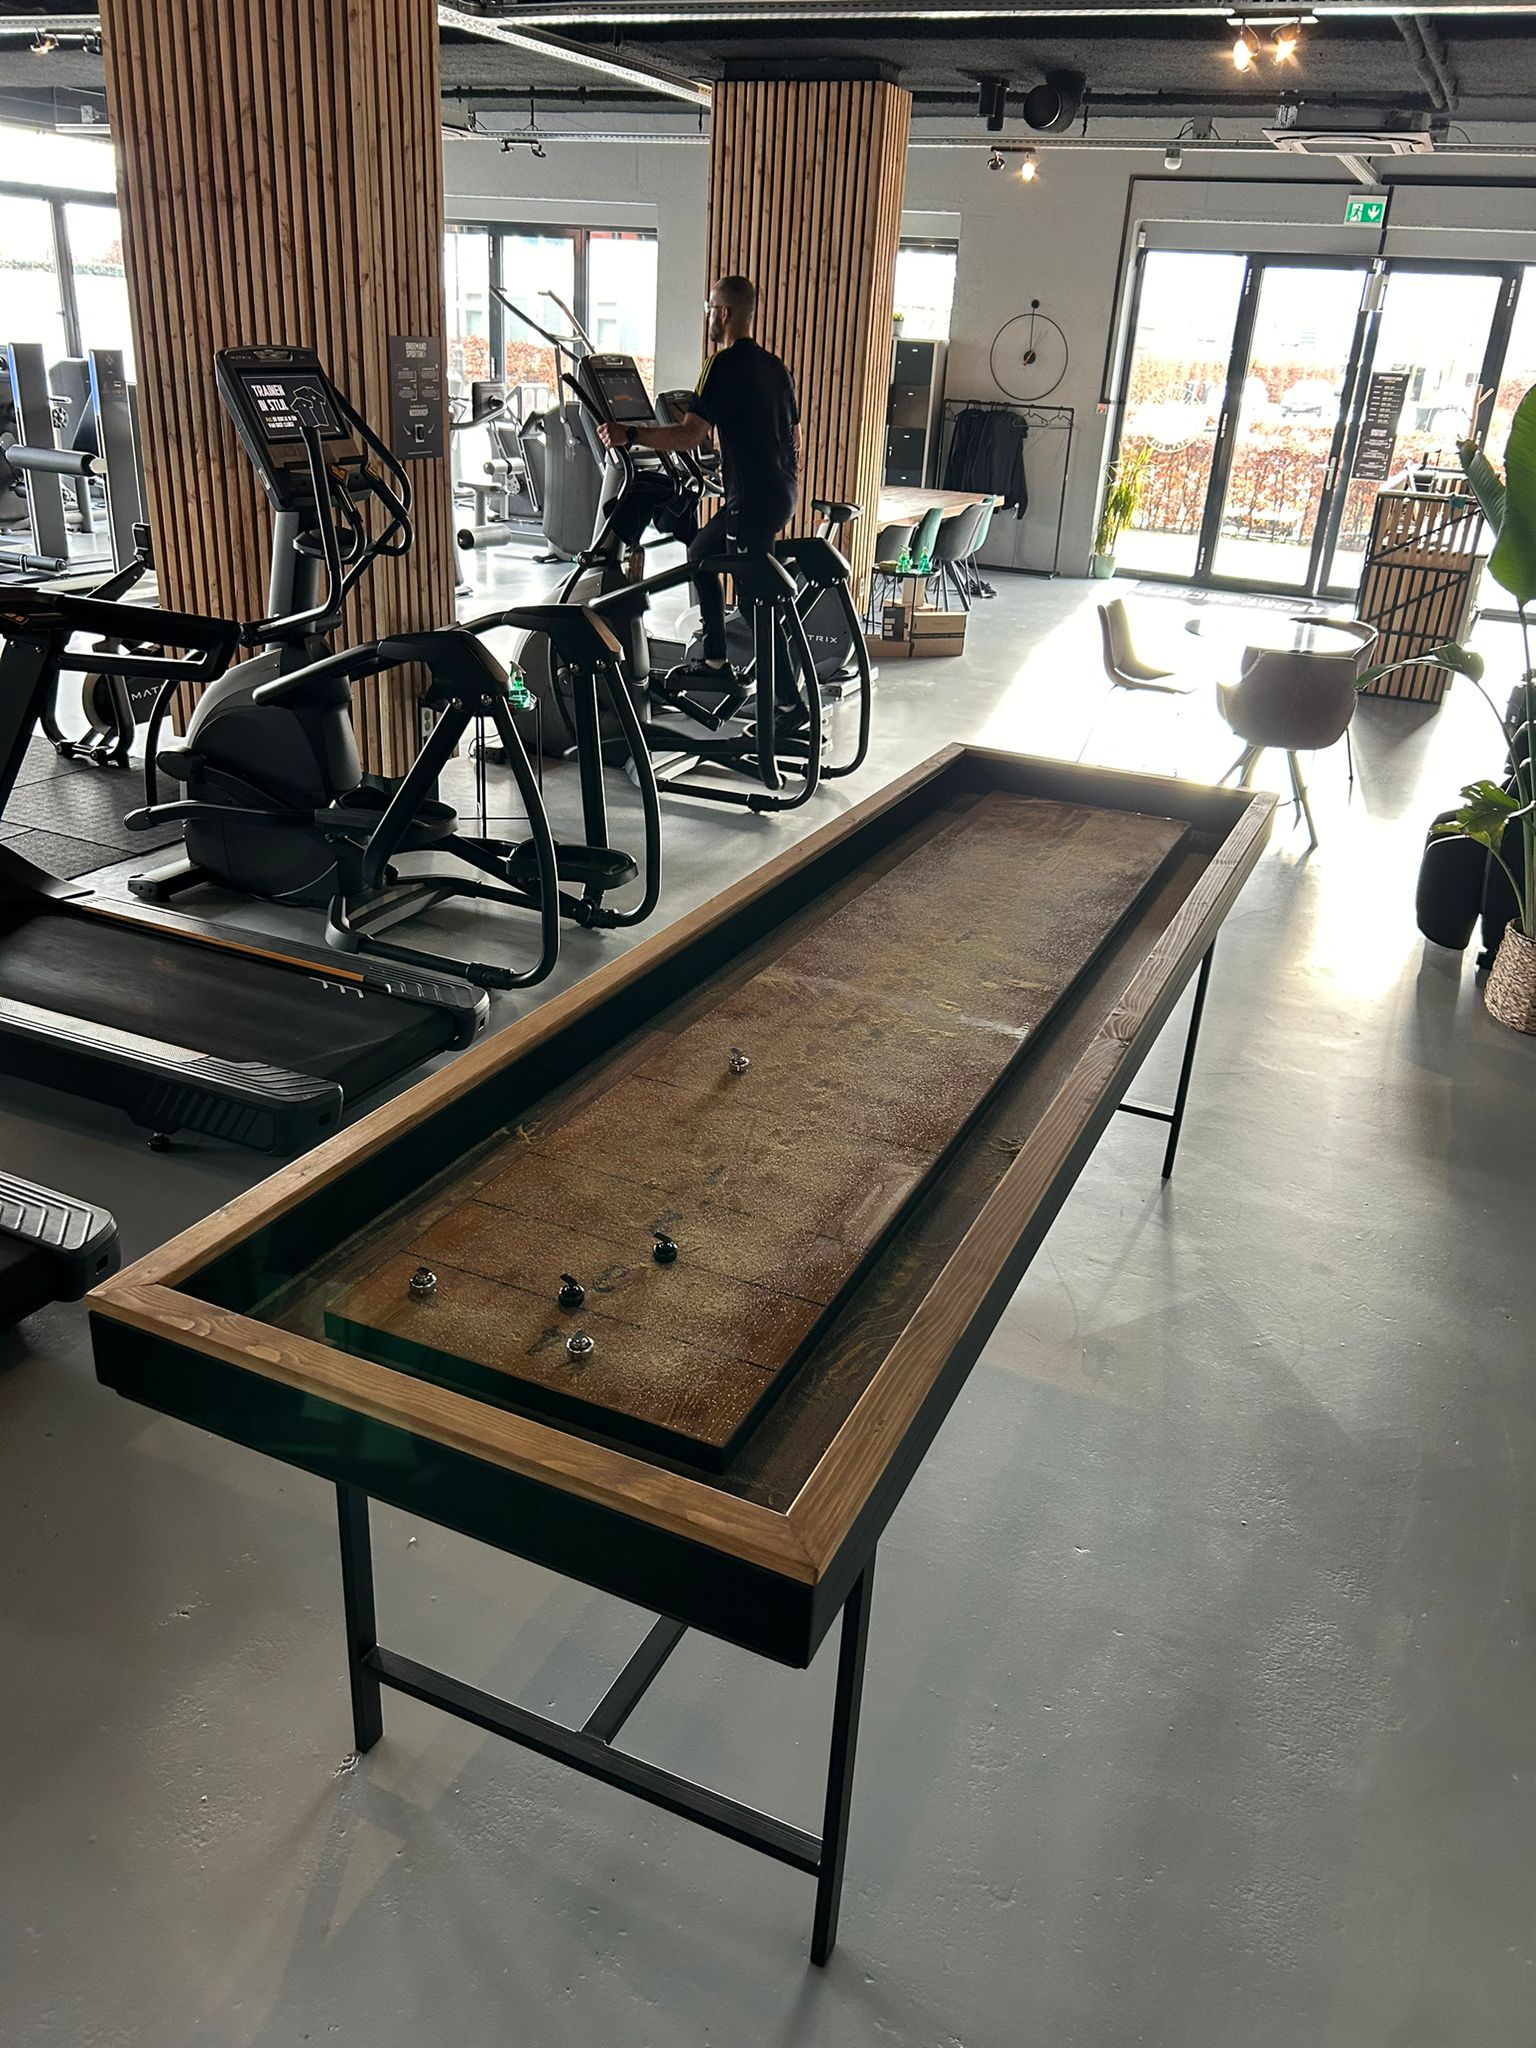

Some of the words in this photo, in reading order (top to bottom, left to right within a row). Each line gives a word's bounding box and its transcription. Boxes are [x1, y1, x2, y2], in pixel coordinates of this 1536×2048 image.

[250, 384, 286, 397] TRAINEN
[257, 399, 269, 412] IN
[266, 398, 290, 411] STIJL
[131, 685, 163, 701] MAT
